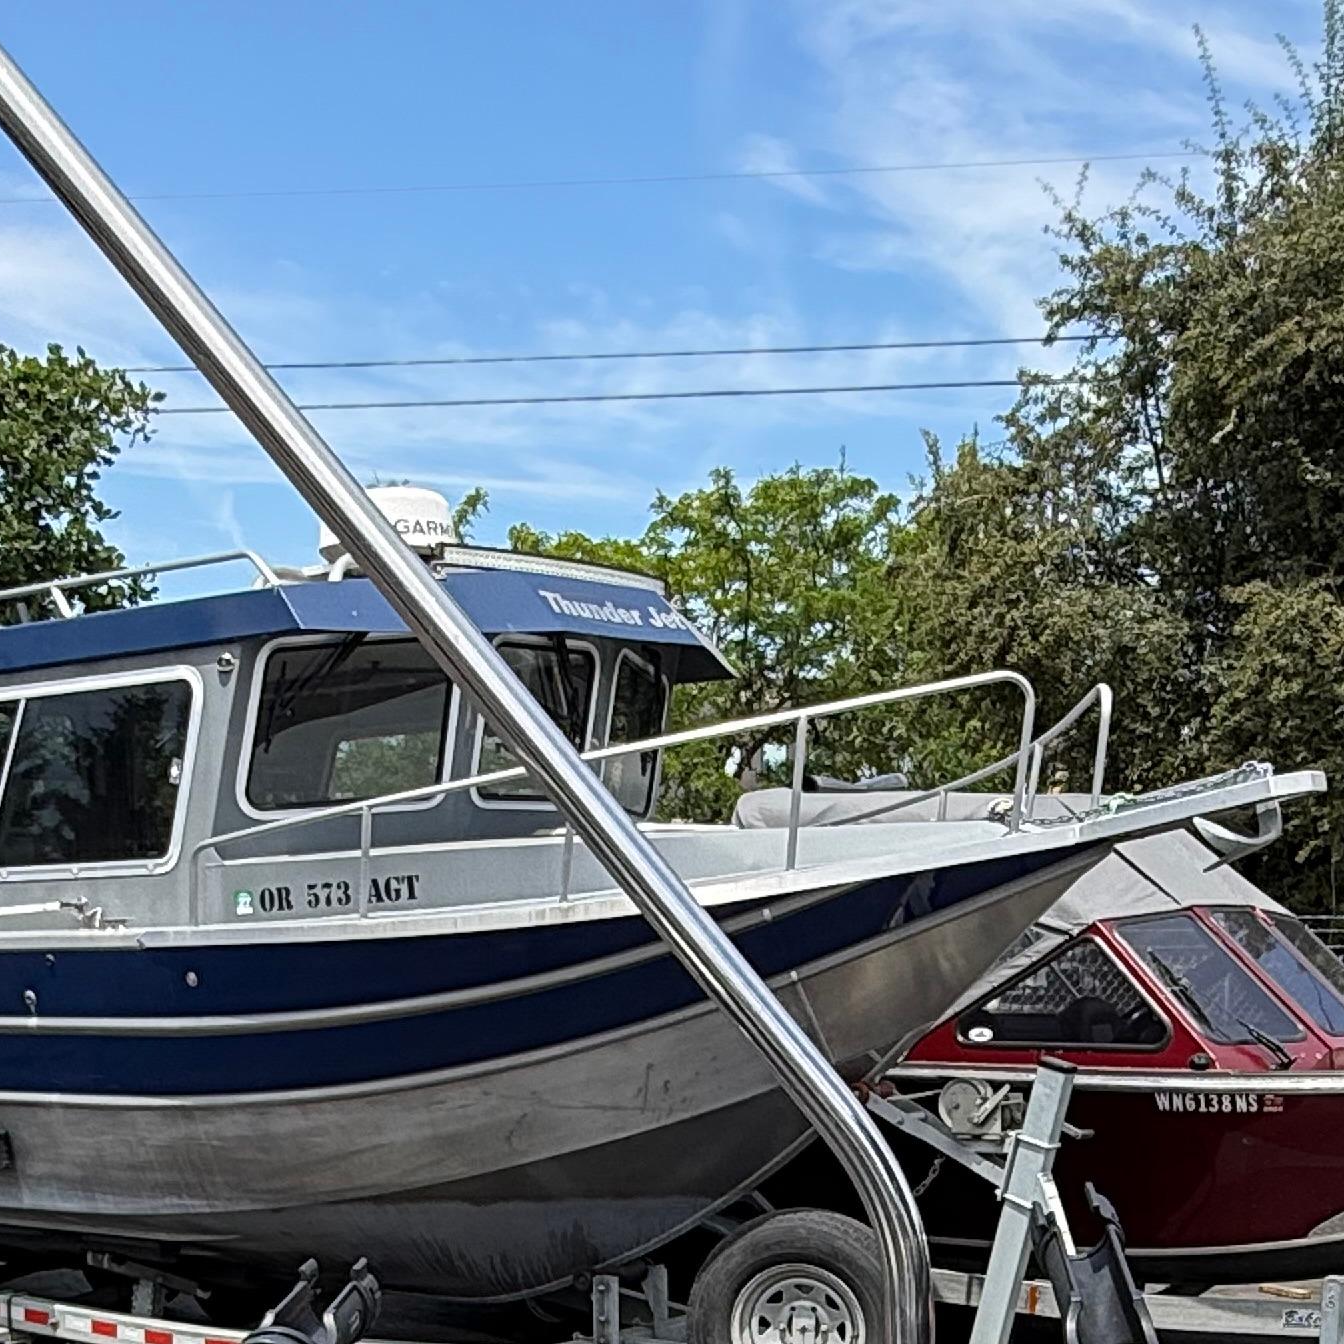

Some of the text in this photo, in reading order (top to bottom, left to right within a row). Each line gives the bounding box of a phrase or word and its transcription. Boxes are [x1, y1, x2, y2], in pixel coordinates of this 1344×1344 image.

[537, 589, 643, 626] Thunder
[259, 887, 294, 912] OR
[306, 881, 352, 908] 573
[367, 874, 420, 904] AGT
